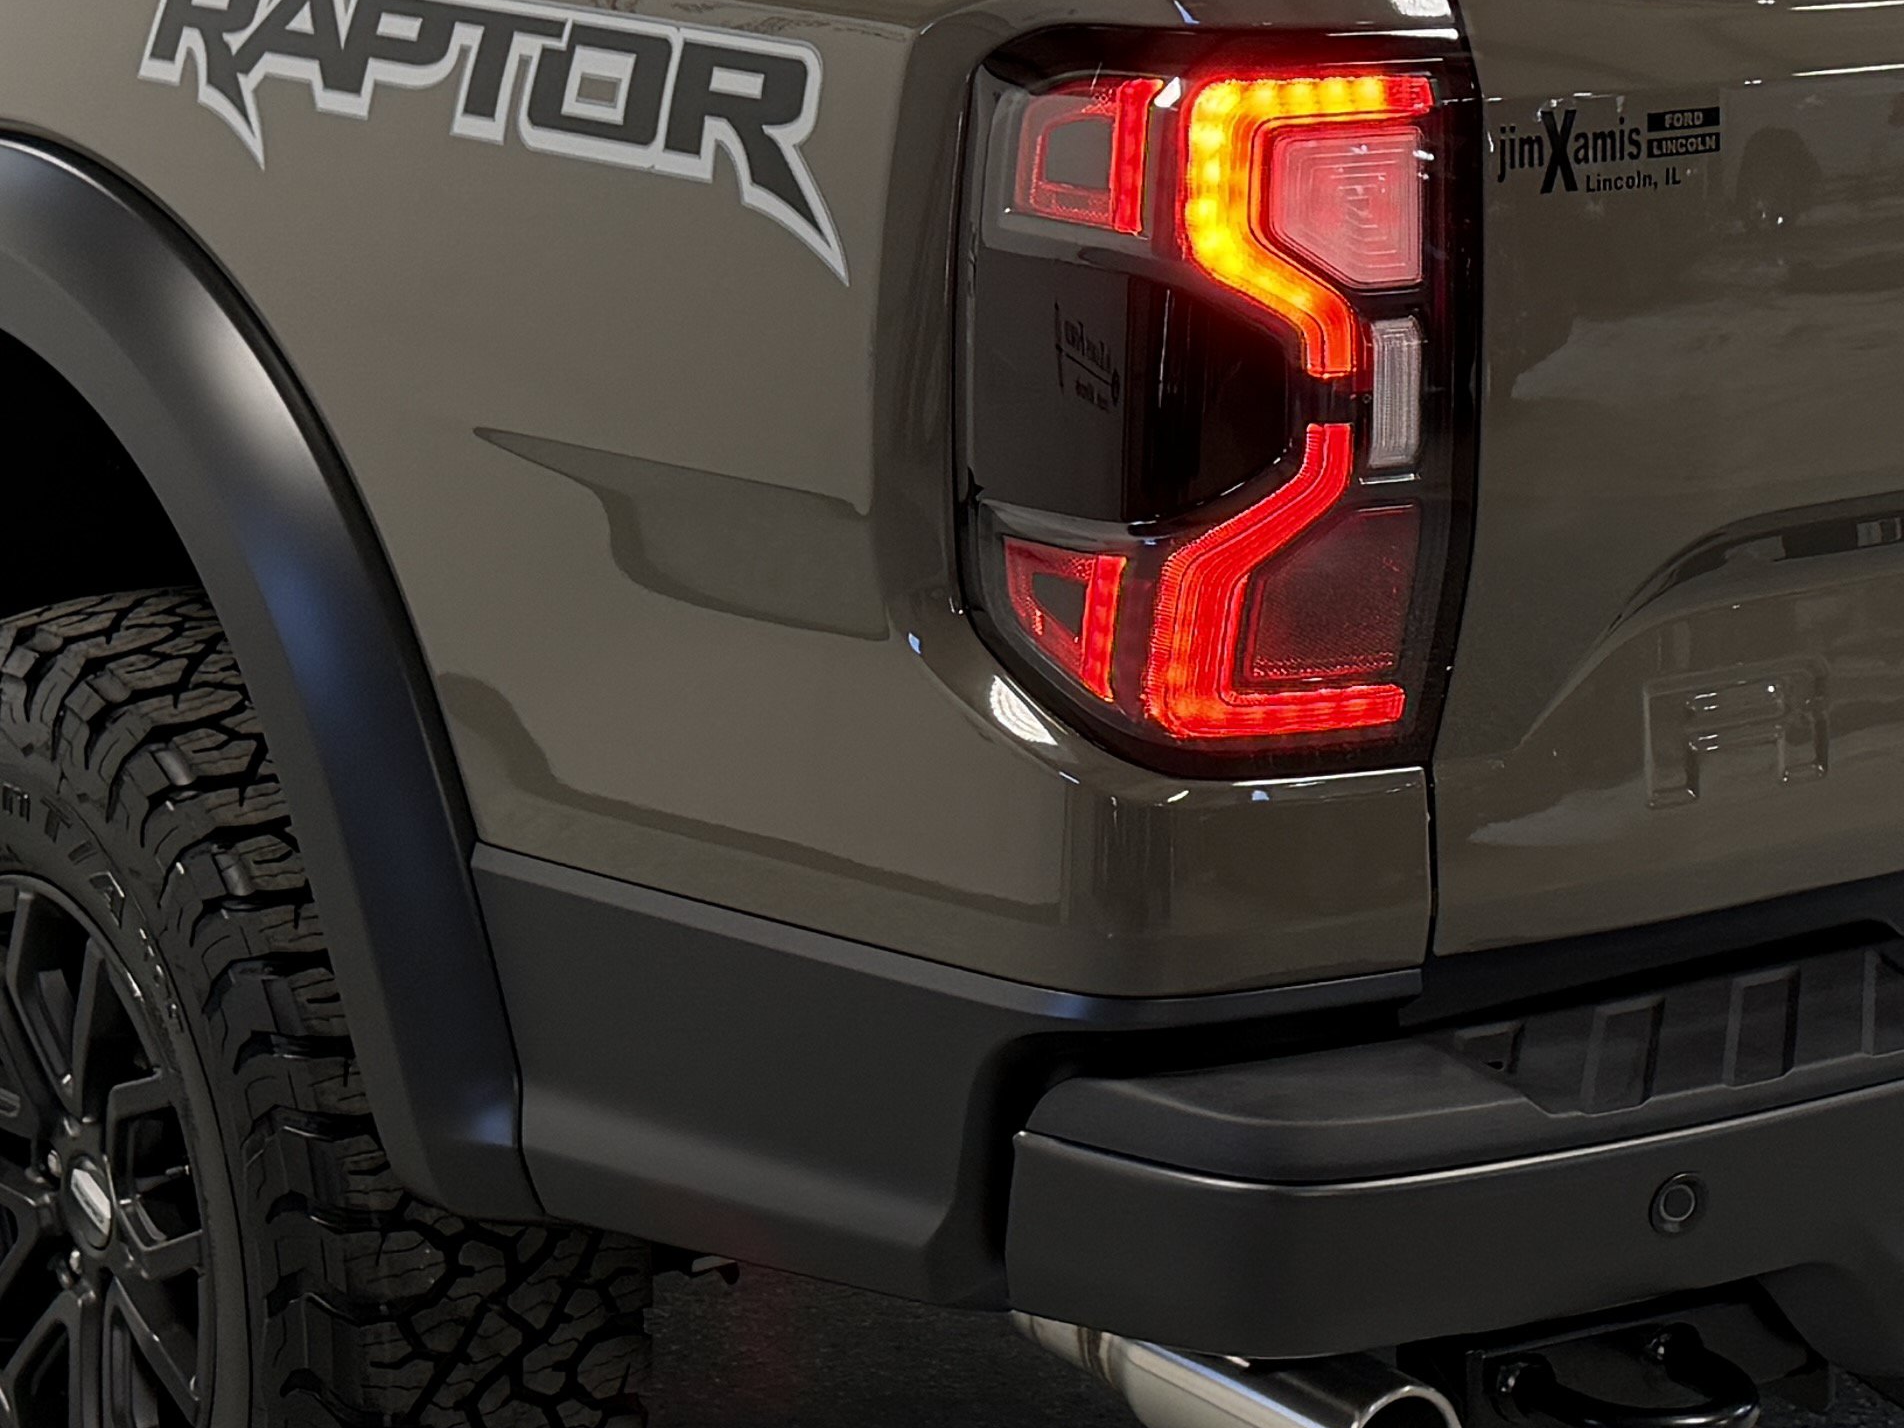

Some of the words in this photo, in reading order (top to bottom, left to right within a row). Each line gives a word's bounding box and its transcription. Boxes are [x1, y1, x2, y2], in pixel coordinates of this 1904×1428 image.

[1664, 111, 1703, 127] FORD
[1497, 109, 1641, 194] jimXamis
[1652, 135, 1717, 155] LINCOLN
[1585, 170, 1658, 193] Lincoln,
[1665, 167, 1681, 186] IL
